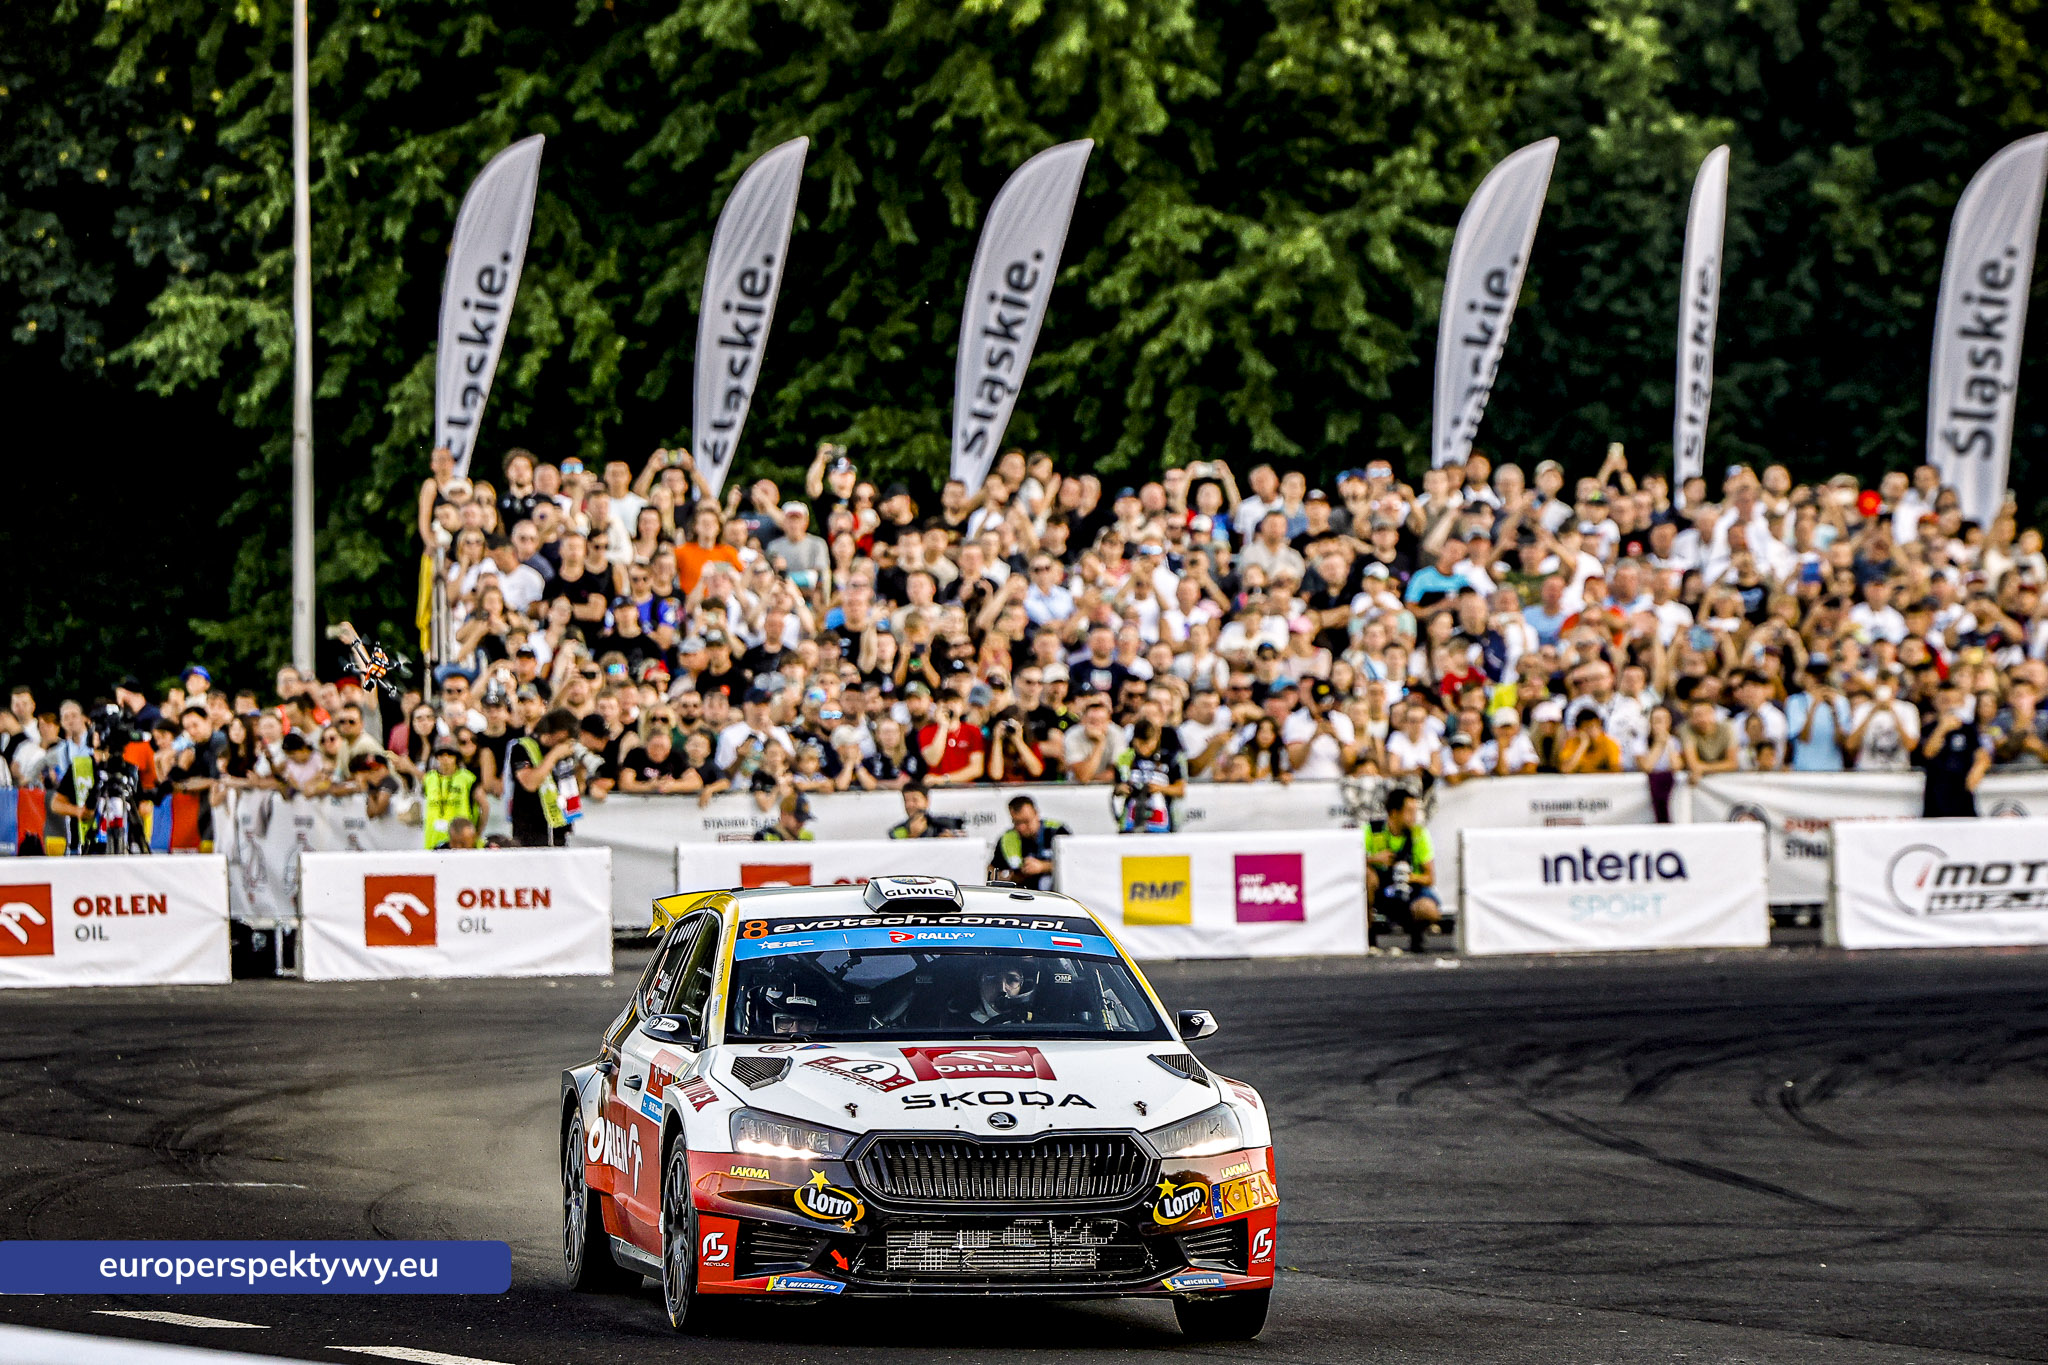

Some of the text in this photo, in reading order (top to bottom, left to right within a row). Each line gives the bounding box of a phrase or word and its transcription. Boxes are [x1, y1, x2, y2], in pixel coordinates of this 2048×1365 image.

[1941, 247, 2018, 461] Śląskie.
[1542, 846, 1688, 884] interia
[456, 887, 552, 910] ORLEN
[884, 887, 955, 898] GLIWICE
[1128, 880, 1186, 903] RMF
[73, 893, 168, 918] ORLEN
[1568, 893, 1667, 921] SPORT
[74, 924, 110, 942] OIL
[457, 916, 493, 934] OIL
[742, 920, 769, 940] 8
[773, 915, 1070, 933] evotech.com.pl
[851, 1064, 885, 1074] 8
[934, 1063, 1035, 1073] ORLEN
[901, 1090, 1098, 1110] SKODA
[587, 1116, 629, 1176] ORLEN
[730, 1165, 771, 1180] LAKMA
[1220, 1162, 1251, 1179] LAKMA
[807, 1187, 852, 1215] LOTTO
[1163, 1187, 1201, 1218] LOTTO
[1214, 1204, 1223, 1214] PL
[787, 1281, 838, 1291] MICHELIN
[1182, 1278, 1220, 1286] MICHELIN
